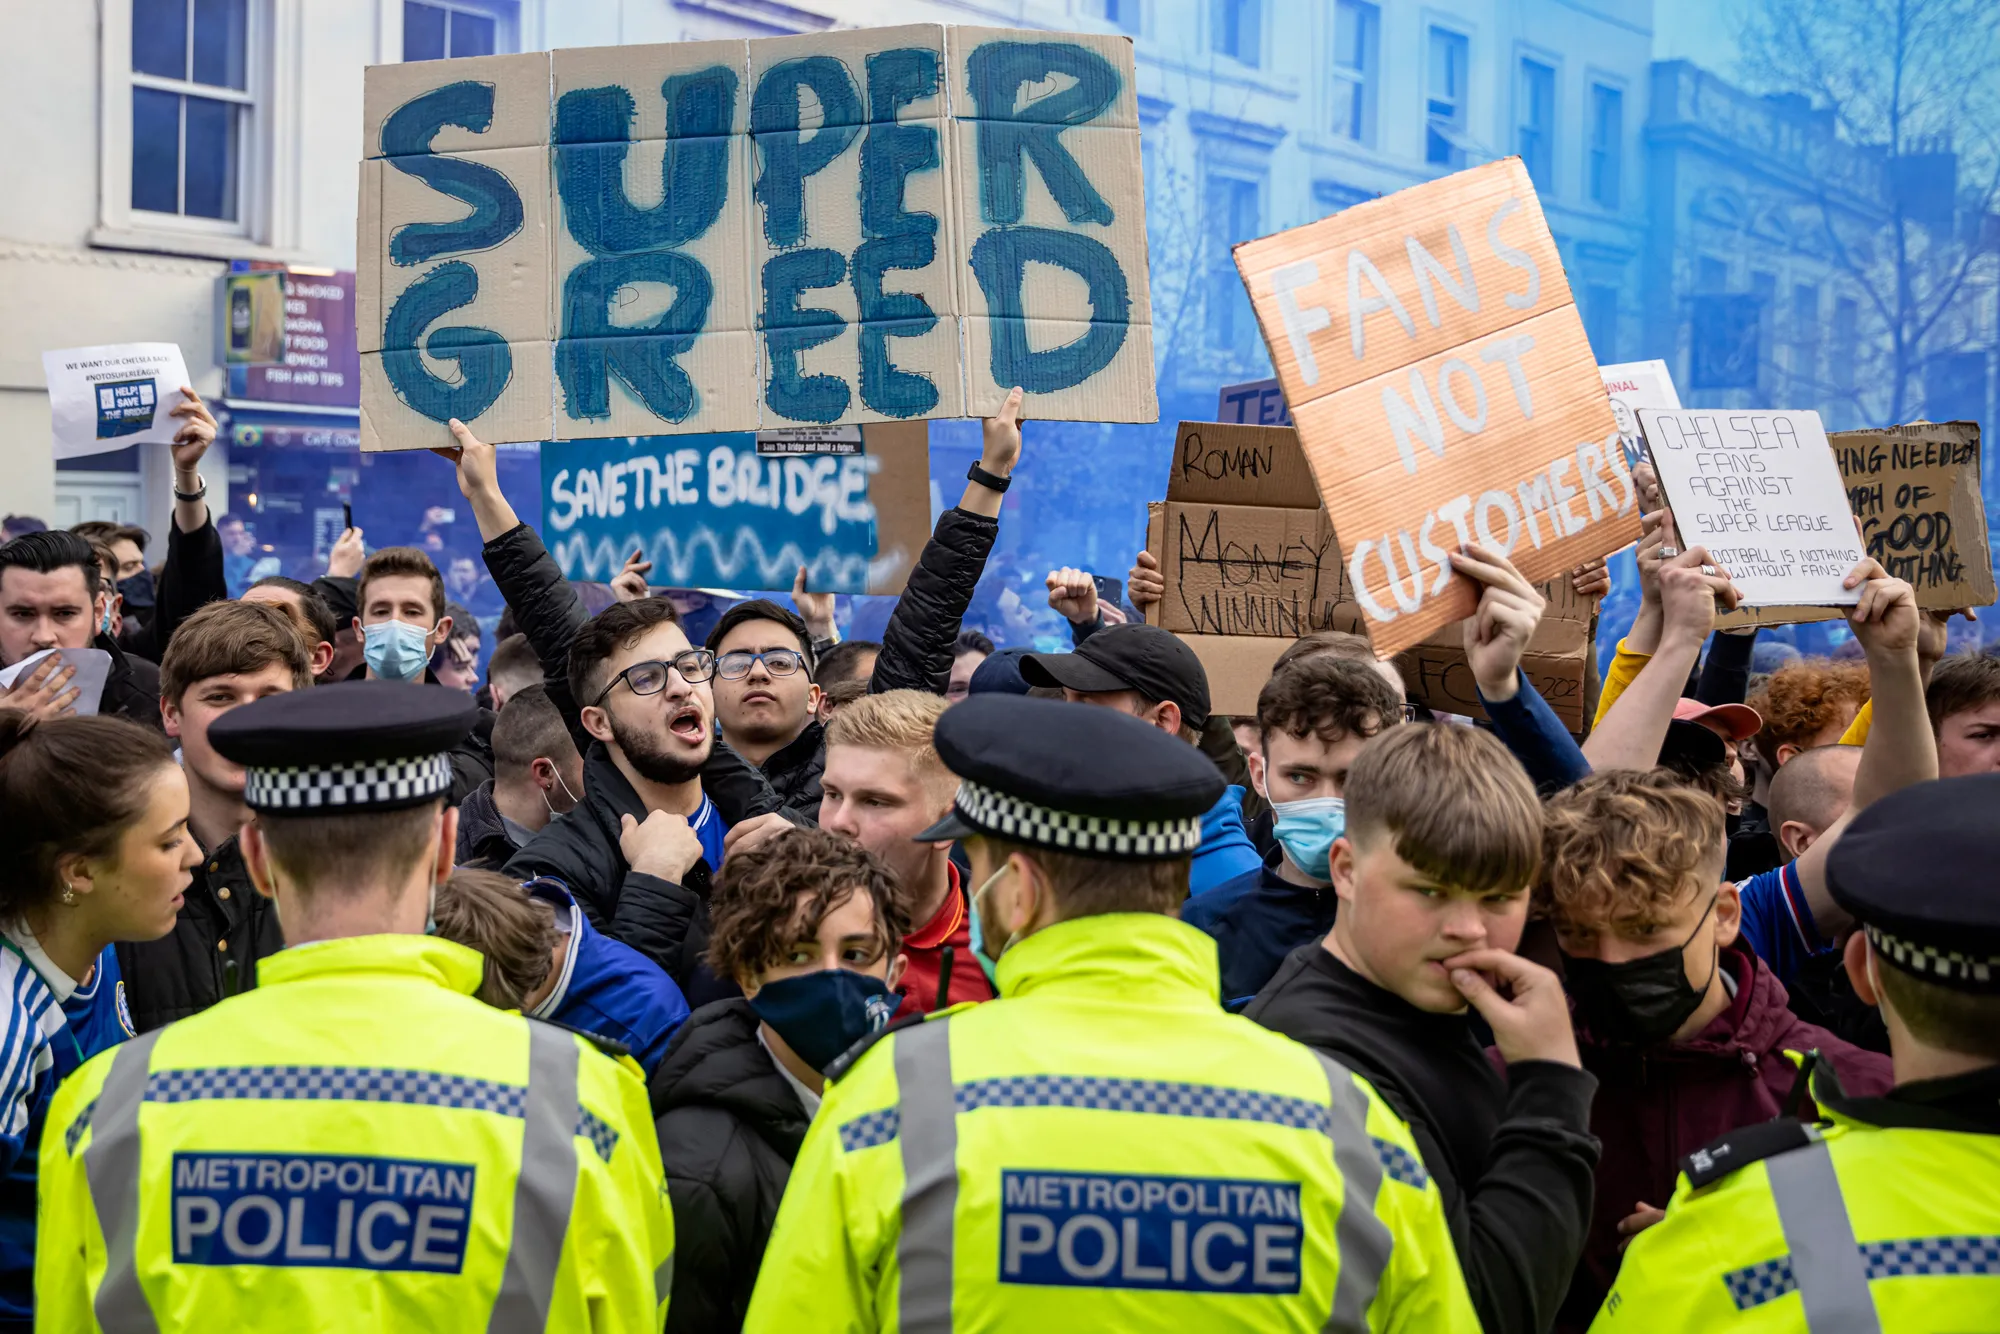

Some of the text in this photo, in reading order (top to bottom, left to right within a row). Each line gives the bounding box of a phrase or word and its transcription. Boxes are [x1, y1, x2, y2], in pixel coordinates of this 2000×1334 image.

[380, 40, 1123, 267] SUPER
[1271, 196, 1541, 387] FANS
[381, 226, 1130, 425] GREED
[65, 360, 78, 370] WE
[80, 360, 103, 369] WANT
[105, 359, 121, 367] OUR
[121, 356, 152, 366] CHELSEA
[114, 385, 139, 397] HELP!
[115, 397, 140, 408] SAVE
[1380, 334, 1537, 477] NOT
[104, 406, 152, 421] THE BRIDGE
[763, 443, 776, 451] Save
[777, 443, 787, 451] The
[787, 443, 805, 452] Bridge
[805, 443, 816, 451] and
[817, 443, 831, 451] build
[837, 443, 856, 452] future.
[1656, 415, 1800, 450] CHELSEA
[1182, 432, 1273, 483] ROMAN
[1695, 452, 1766, 474] FANS
[707, 446, 881, 536] BRIDGE
[1688, 476, 1794, 497] AGAINST
[1894, 483, 1936, 509] OF
[1717, 498, 1758, 513] THE
[1347, 431, 1635, 623] CUSTOMERS
[1696, 513, 1833, 534] SUPER LEAGUE
[1863, 511, 1953, 557] GOOD
[1707, 547, 1859, 564] OOTBALL IS NOTHING
[1728, 564, 1793, 579] WITHOUT
[176, 1158, 472, 1201] METROPOLITAN
[1004, 1174, 1300, 1220] METROPOLITAN
[176, 1194, 465, 1267] POLICE
[1003, 1213, 1298, 1286] POLICE
